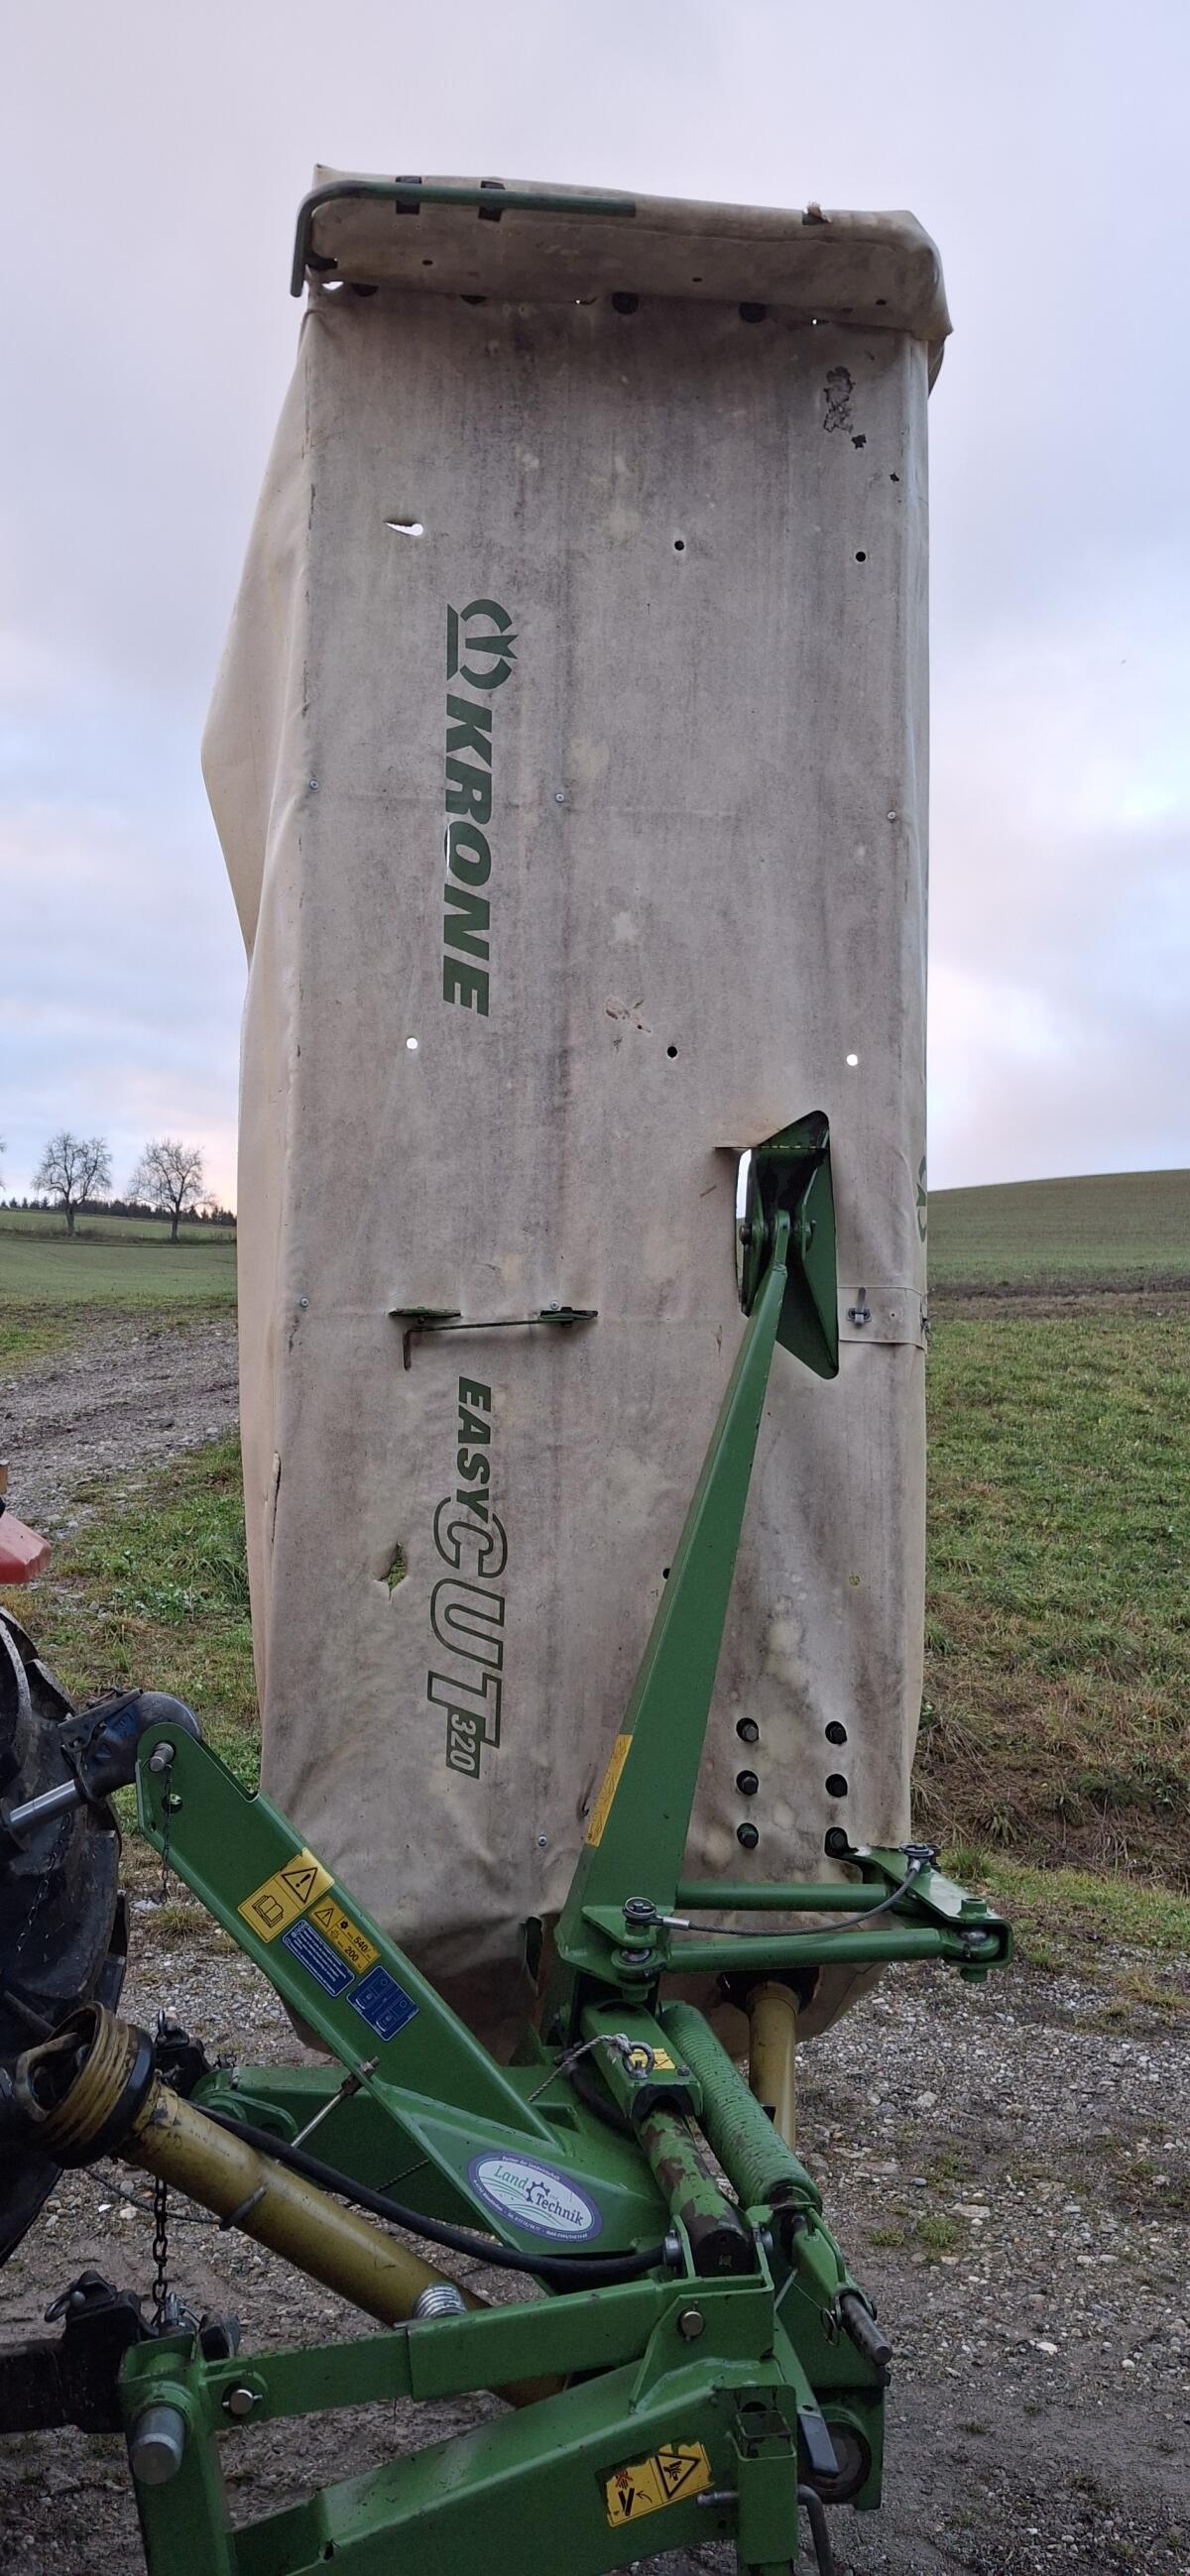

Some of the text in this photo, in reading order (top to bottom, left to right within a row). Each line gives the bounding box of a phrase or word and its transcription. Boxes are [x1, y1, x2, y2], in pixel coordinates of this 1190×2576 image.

[443, 693, 494, 1017] KRONE
[450, 1713, 477, 1772] 320
[344, 1945, 359, 1962] 200
[494, 2166, 529, 2189] Land
[536, 2192, 583, 2226] Technik
